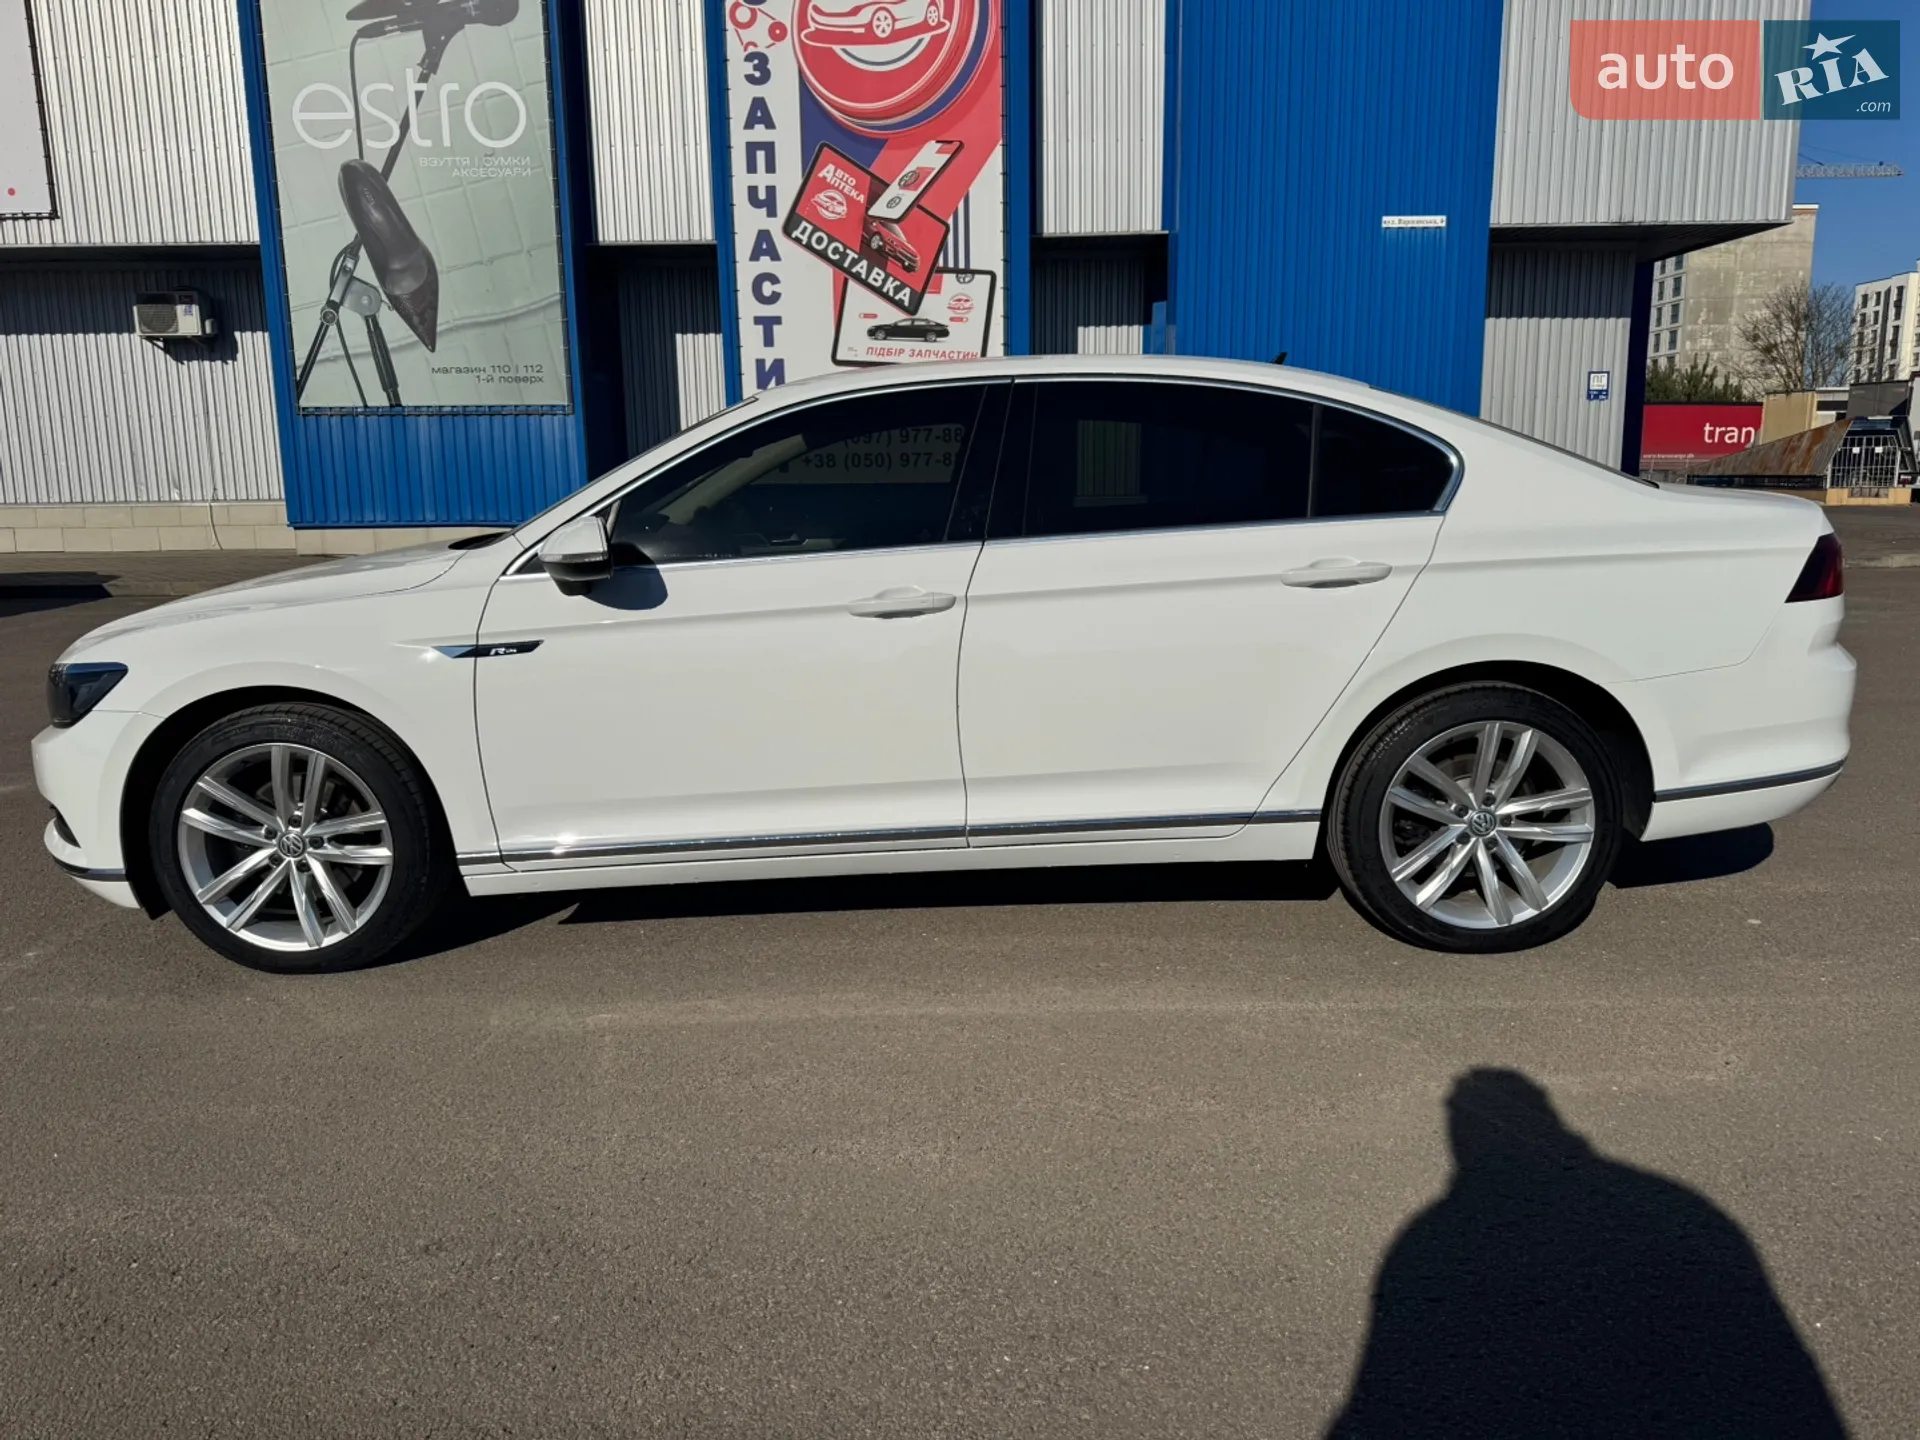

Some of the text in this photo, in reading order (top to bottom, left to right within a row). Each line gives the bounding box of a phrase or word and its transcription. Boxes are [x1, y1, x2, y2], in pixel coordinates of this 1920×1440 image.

[292, 68, 527, 150] estro
[420, 156, 531, 167] ВЗУТТЯ СУМКИ
[452, 168, 531, 178] АКСЕСУАРИ
[791, 221, 912, 307] ДОСТАВКА
[866, 347, 905, 358] ПІДБІР
[908, 349, 979, 360] ЗАПЧАСТИН
[431, 364, 544, 375] магазин 110 112
[475, 374, 545, 385] 1-й поверх
[802, 452, 954, 473] +38 (050) 977-8
